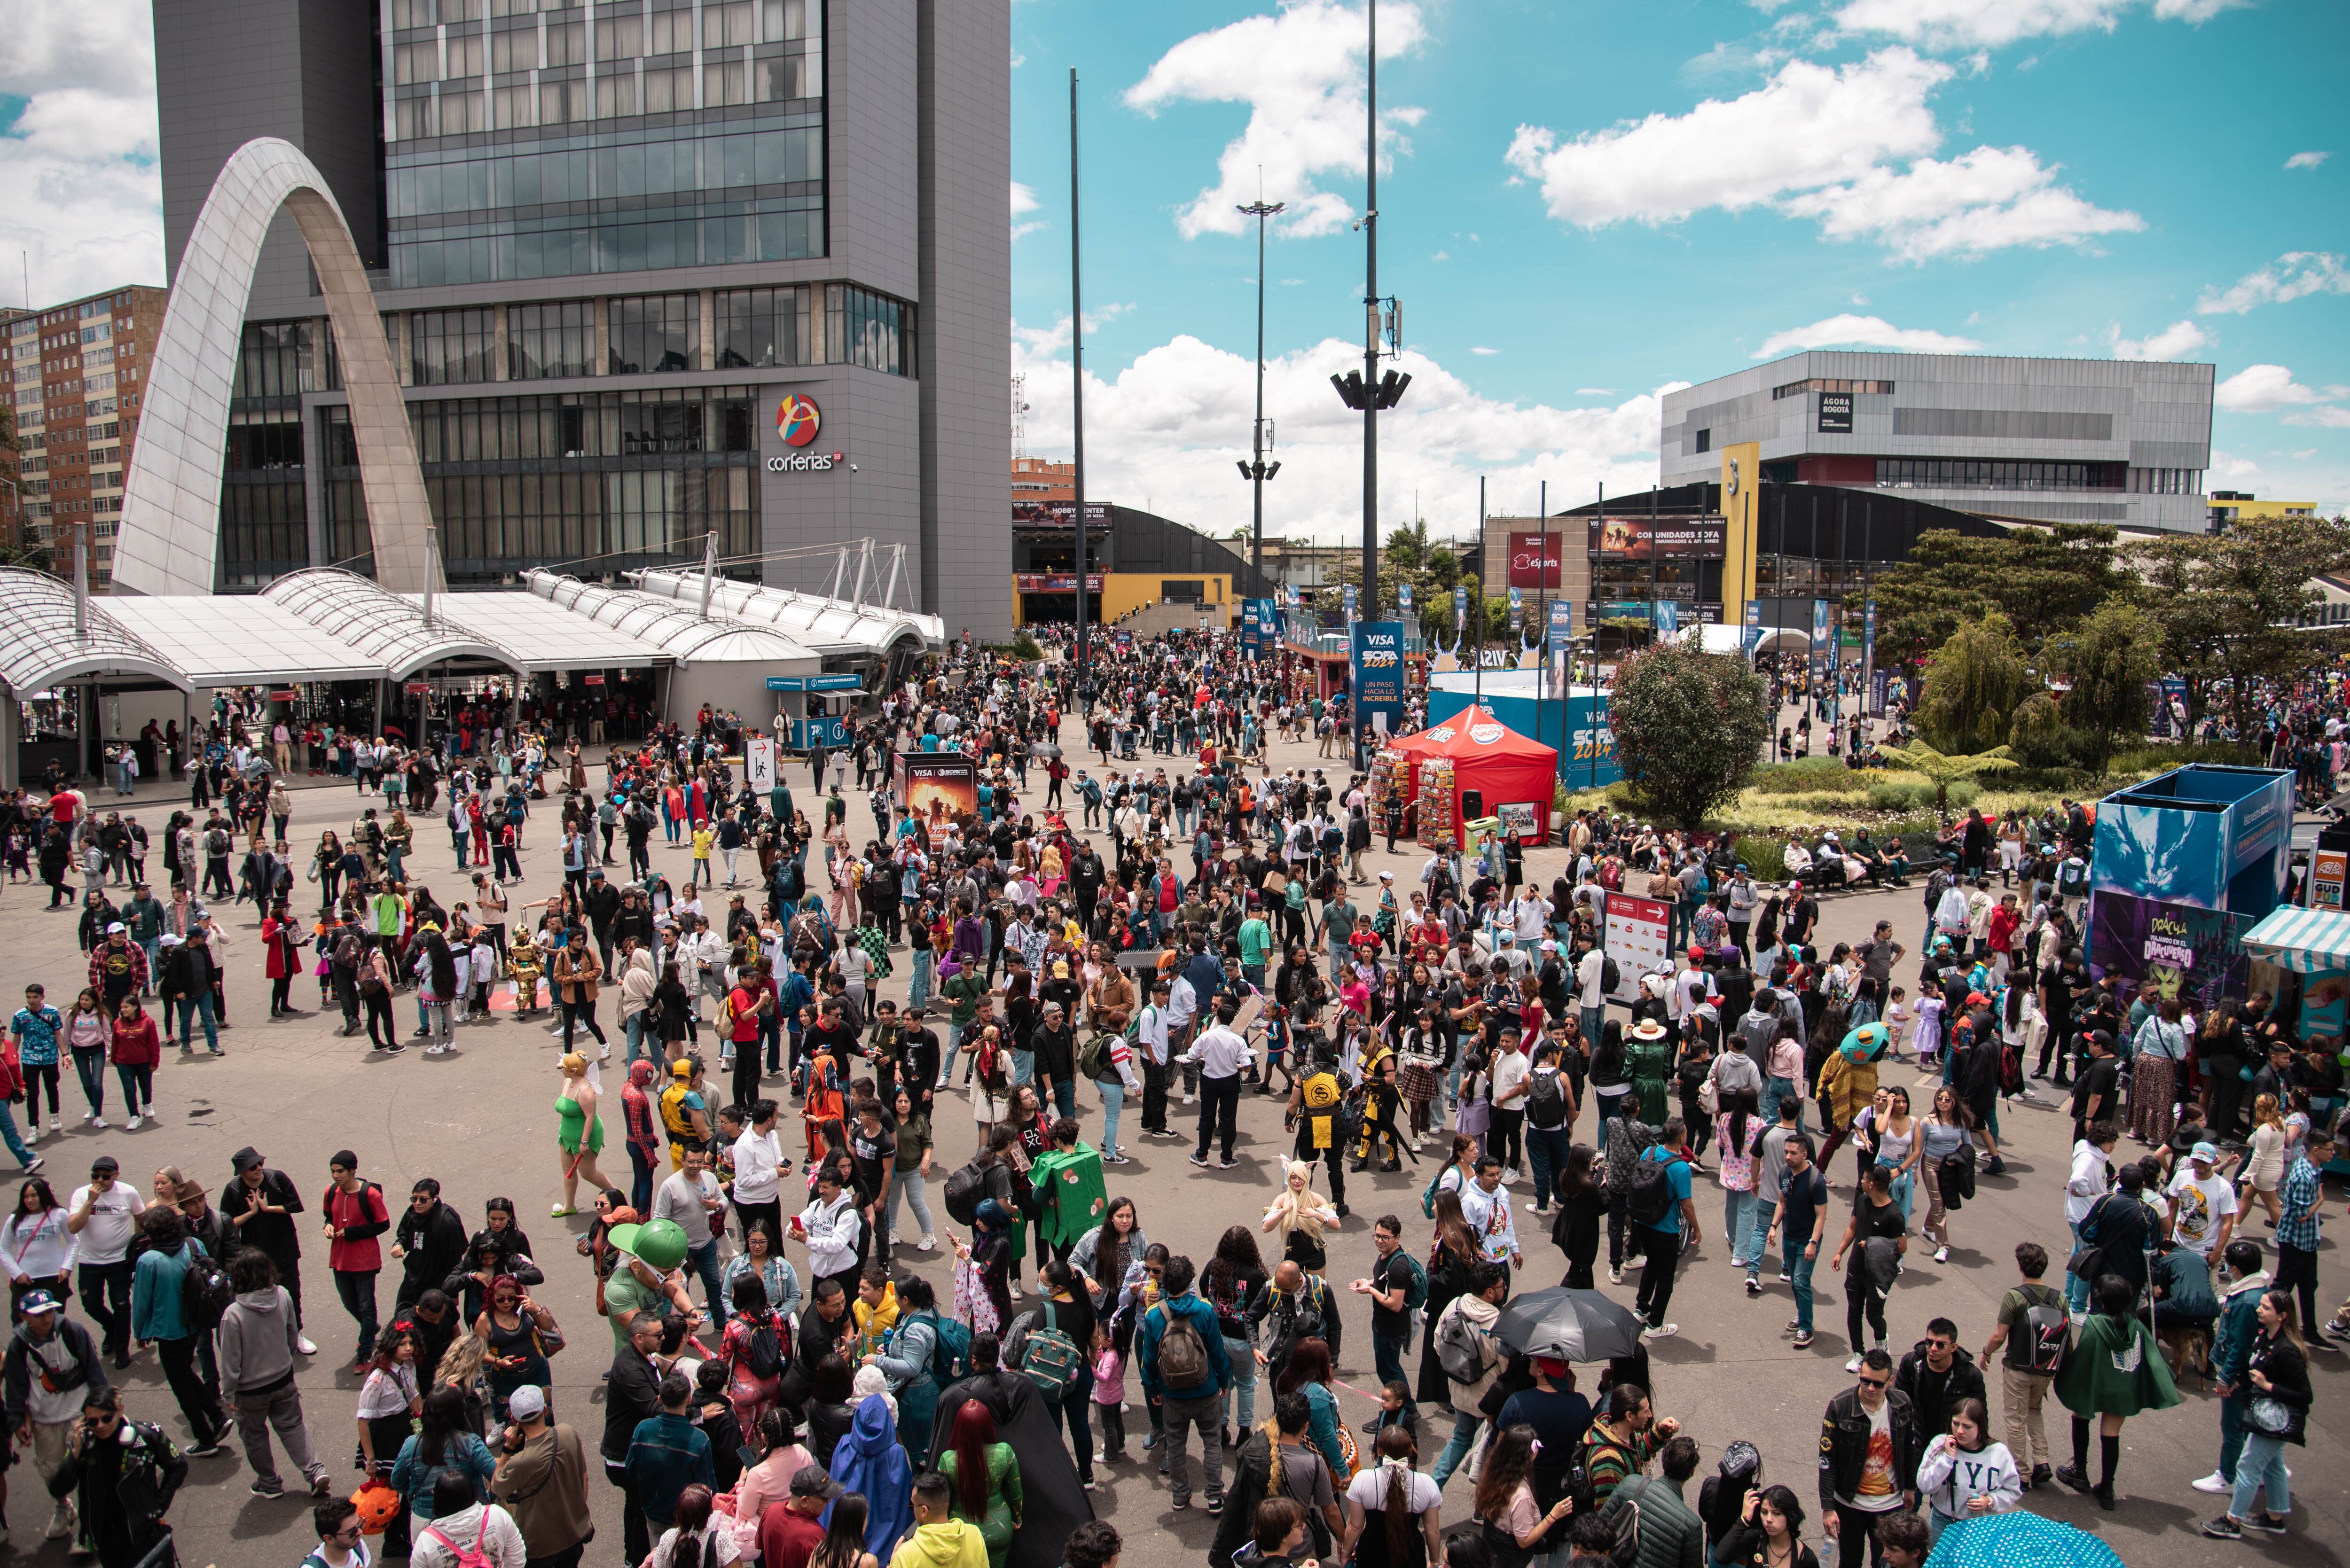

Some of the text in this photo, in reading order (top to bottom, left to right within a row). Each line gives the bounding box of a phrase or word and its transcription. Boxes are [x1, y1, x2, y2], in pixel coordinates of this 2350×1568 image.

[768, 452, 832, 471] corferias
[1727, 458, 1739, 496] 3
[1214, 578, 1222, 601] 1
[1365, 635, 1394, 645] VISA
[1362, 651, 1399, 660] SOFA
[1363, 659, 1396, 668] 2024
[1585, 711, 1606, 723] VISA
[1572, 728, 1615, 746] SOFA
[1574, 743, 1612, 760] 2024
[2315, 883, 2341, 894] GUD
[2152, 913, 2188, 935] DRÁCULA
[2150, 934, 2172, 944] VIAJANDO
[2144, 940, 2192, 967] DRACUVERSO
